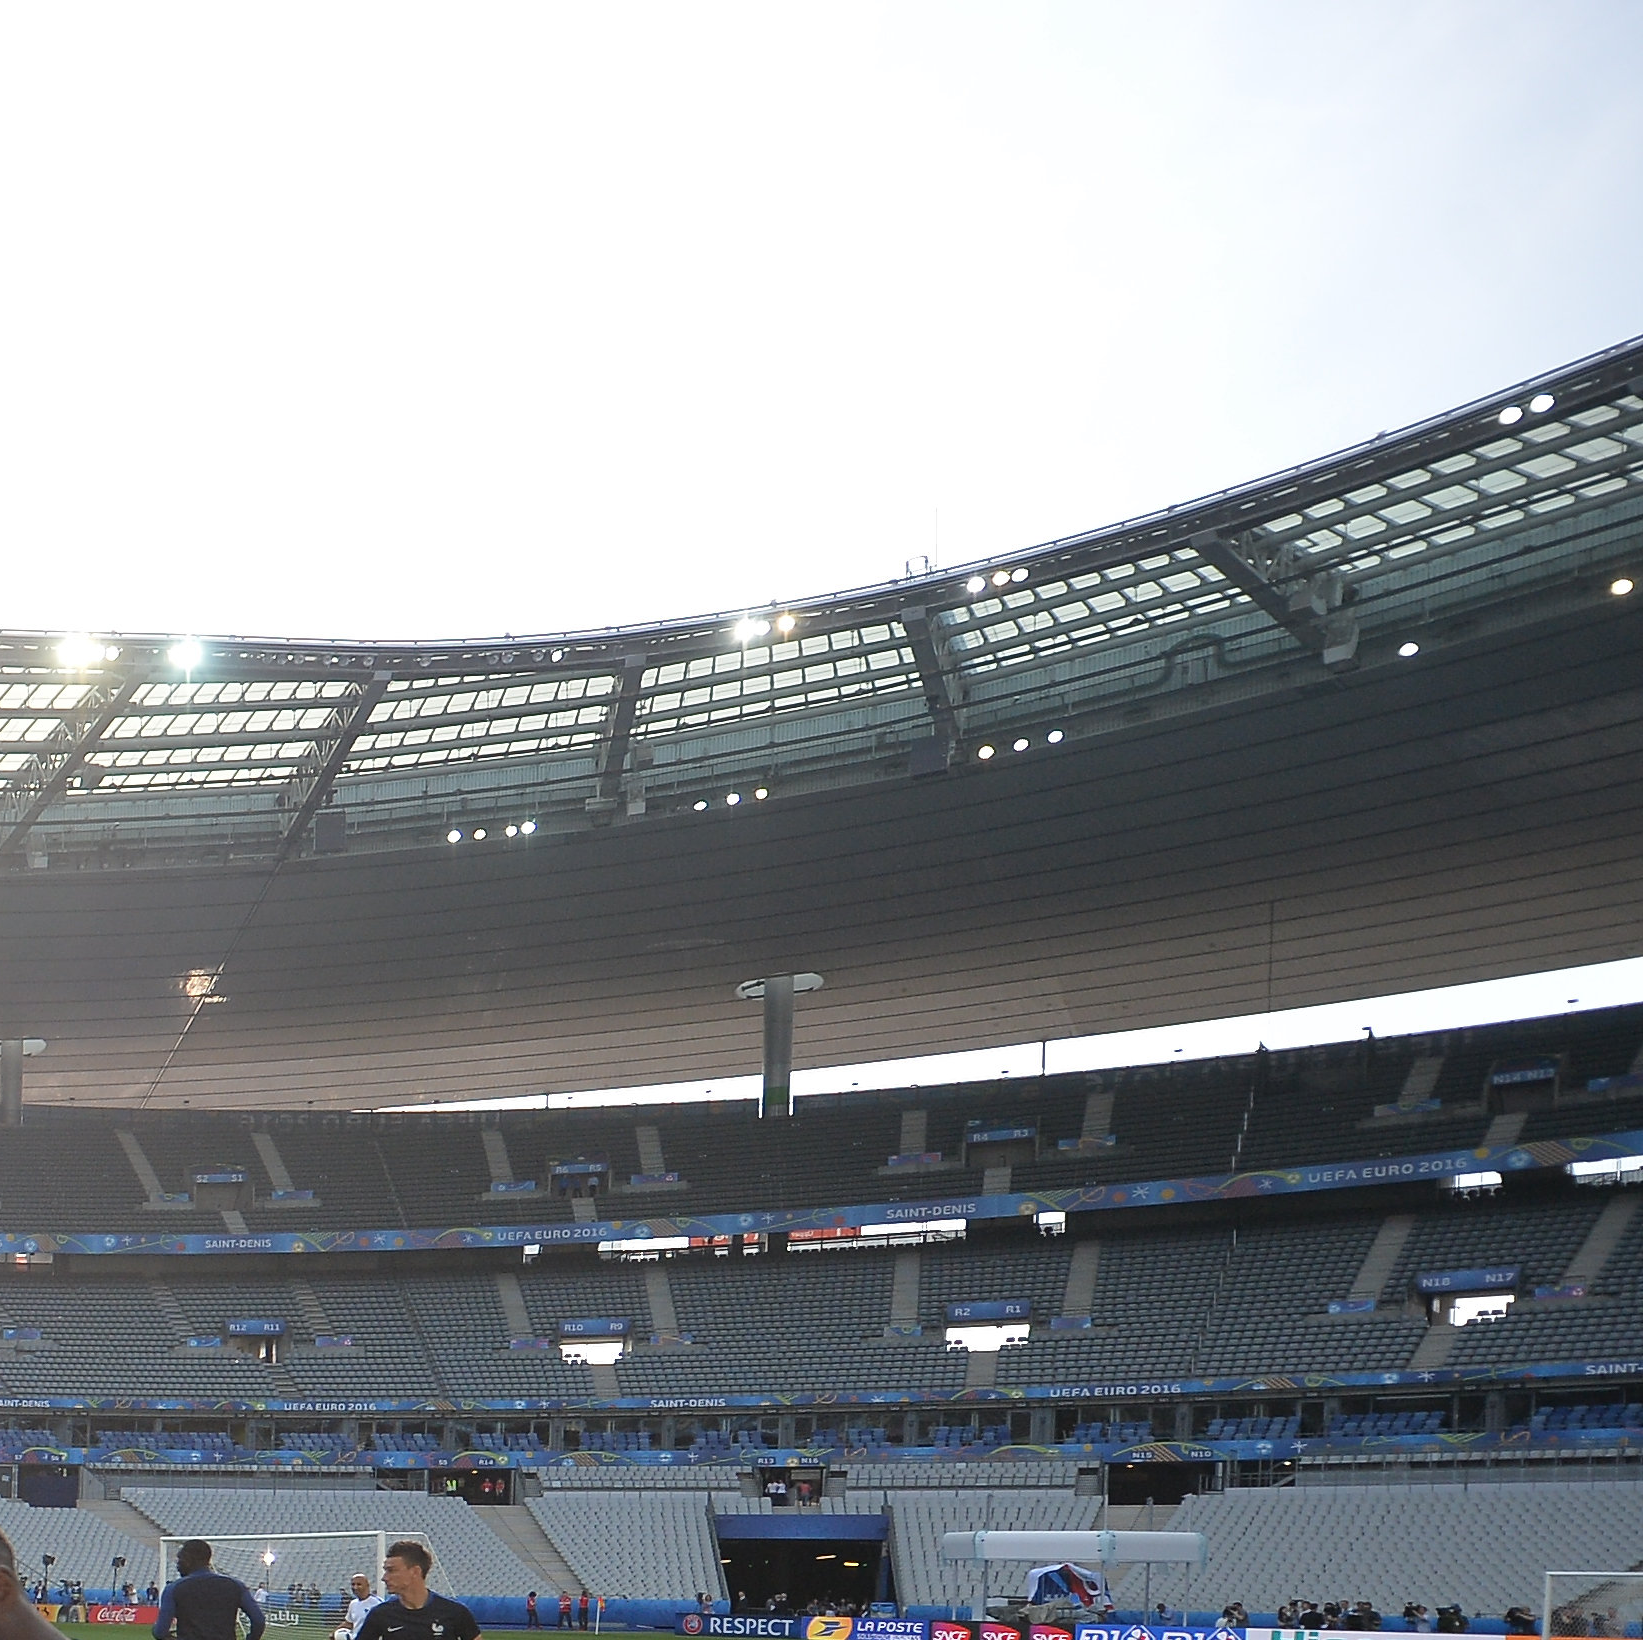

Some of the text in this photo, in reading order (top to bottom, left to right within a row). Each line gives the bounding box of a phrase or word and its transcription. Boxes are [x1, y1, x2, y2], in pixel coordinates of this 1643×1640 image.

[1308, 1158, 1467, 1184] UEFA EURO 2016
[196, 1174, 244, 1183] S2 S1
[886, 1203, 977, 1220] SAINT-DENIS
[497, 1227, 608, 1242] UEFA EURO 2016
[205, 1239, 272, 1249] SAINT-DENIS
[1484, 1272, 1515, 1283] N17
[954, 1305, 1022, 1317] R2 R1
[564, 1323, 584, 1332] R10
[1050, 1383, 1182, 1398] UEFA EURO 2016
[284, 1402, 377, 1411] UEFA EURO 2016
[650, 1398, 726, 1408] SAINT-DENIS
[1191, 1450, 1212, 1459] N10
[97, 1607, 138, 1623] Coca-Cola
[709, 1617, 794, 1636] RESPECT
[857, 1621, 924, 1634] LA POSTE
